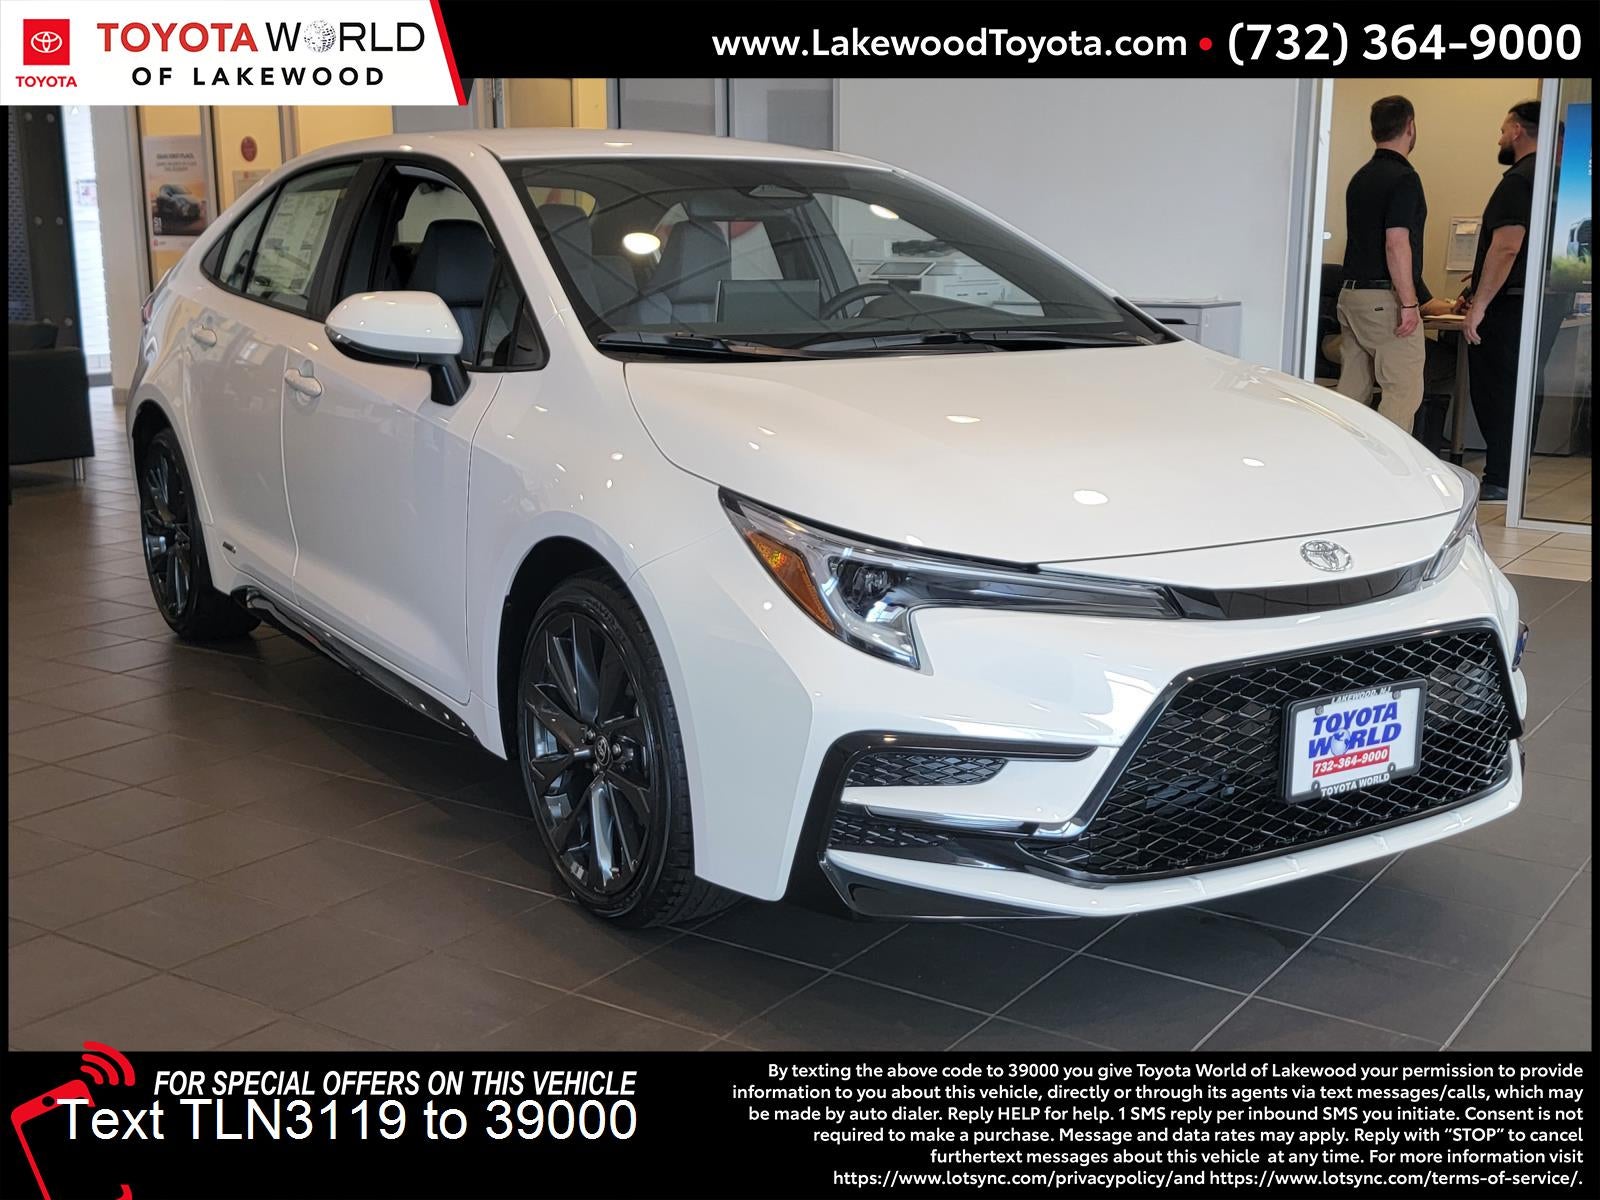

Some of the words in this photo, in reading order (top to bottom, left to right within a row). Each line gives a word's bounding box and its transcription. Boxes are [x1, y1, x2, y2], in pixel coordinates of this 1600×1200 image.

[1312, 702, 1398, 736] TOYOTA
[1308, 723, 1402, 759] WORLD
[1314, 749, 1388, 775] 732-364-9000
[1321, 780, 1357, 797] TOYOTA
[1358, 773, 1391, 789] WORLD
